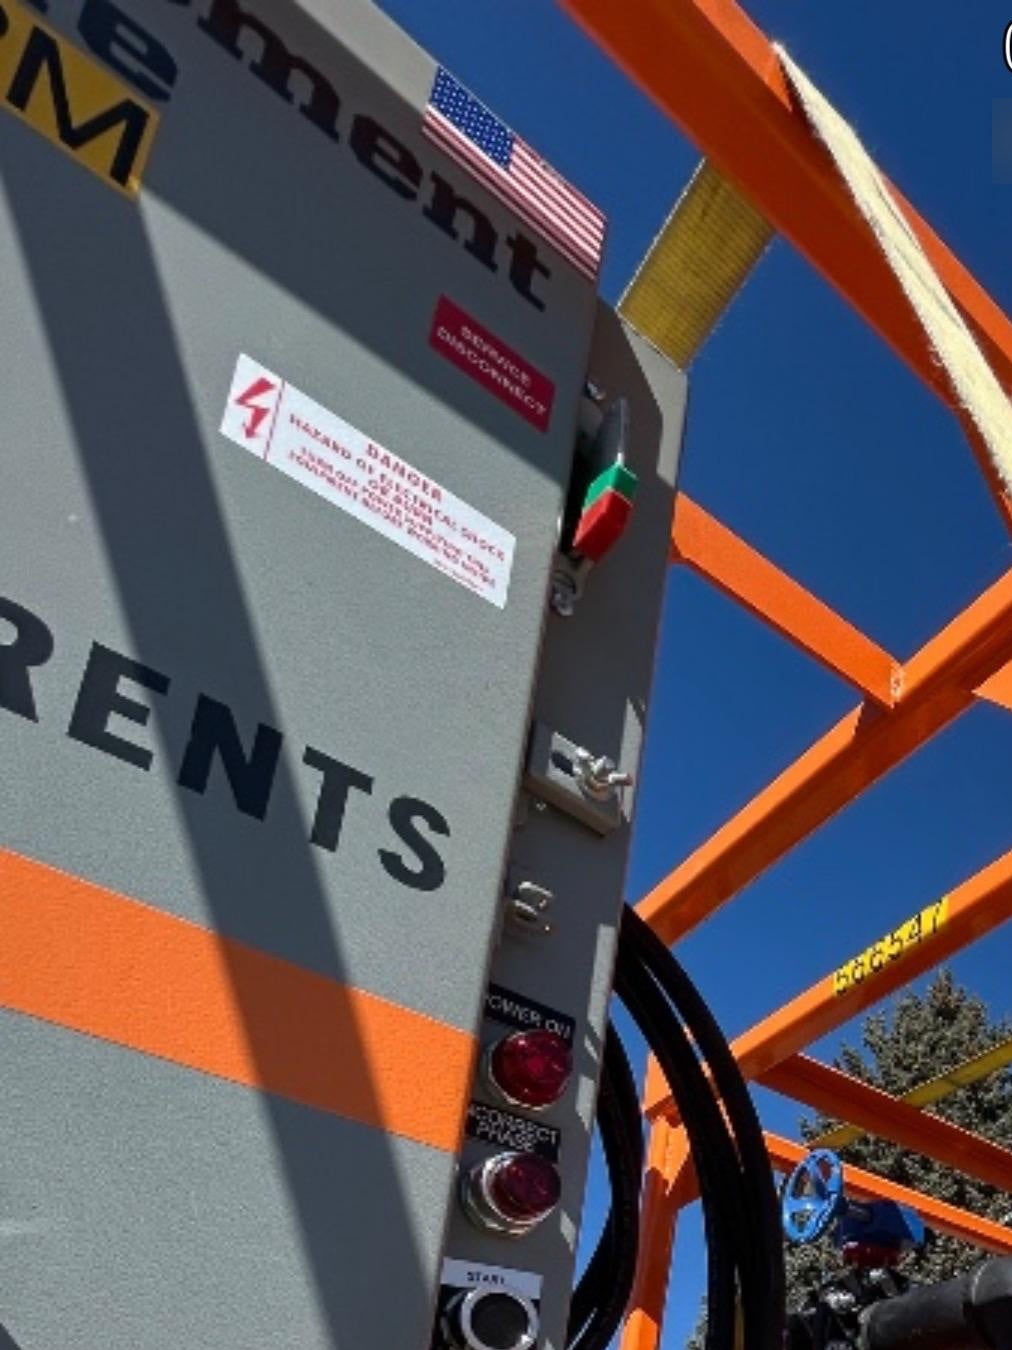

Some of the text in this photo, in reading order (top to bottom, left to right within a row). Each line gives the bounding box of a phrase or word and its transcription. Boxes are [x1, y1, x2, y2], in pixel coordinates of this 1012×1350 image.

[0, 3, 150, 187] M
[168, 0, 551, 312] ment
[288, 412, 352, 461] HAZARD
[365, 441, 442, 503] DANGER
[483, 995, 541, 1028] OWER
[468, 1104, 557, 1145] CORRECT
